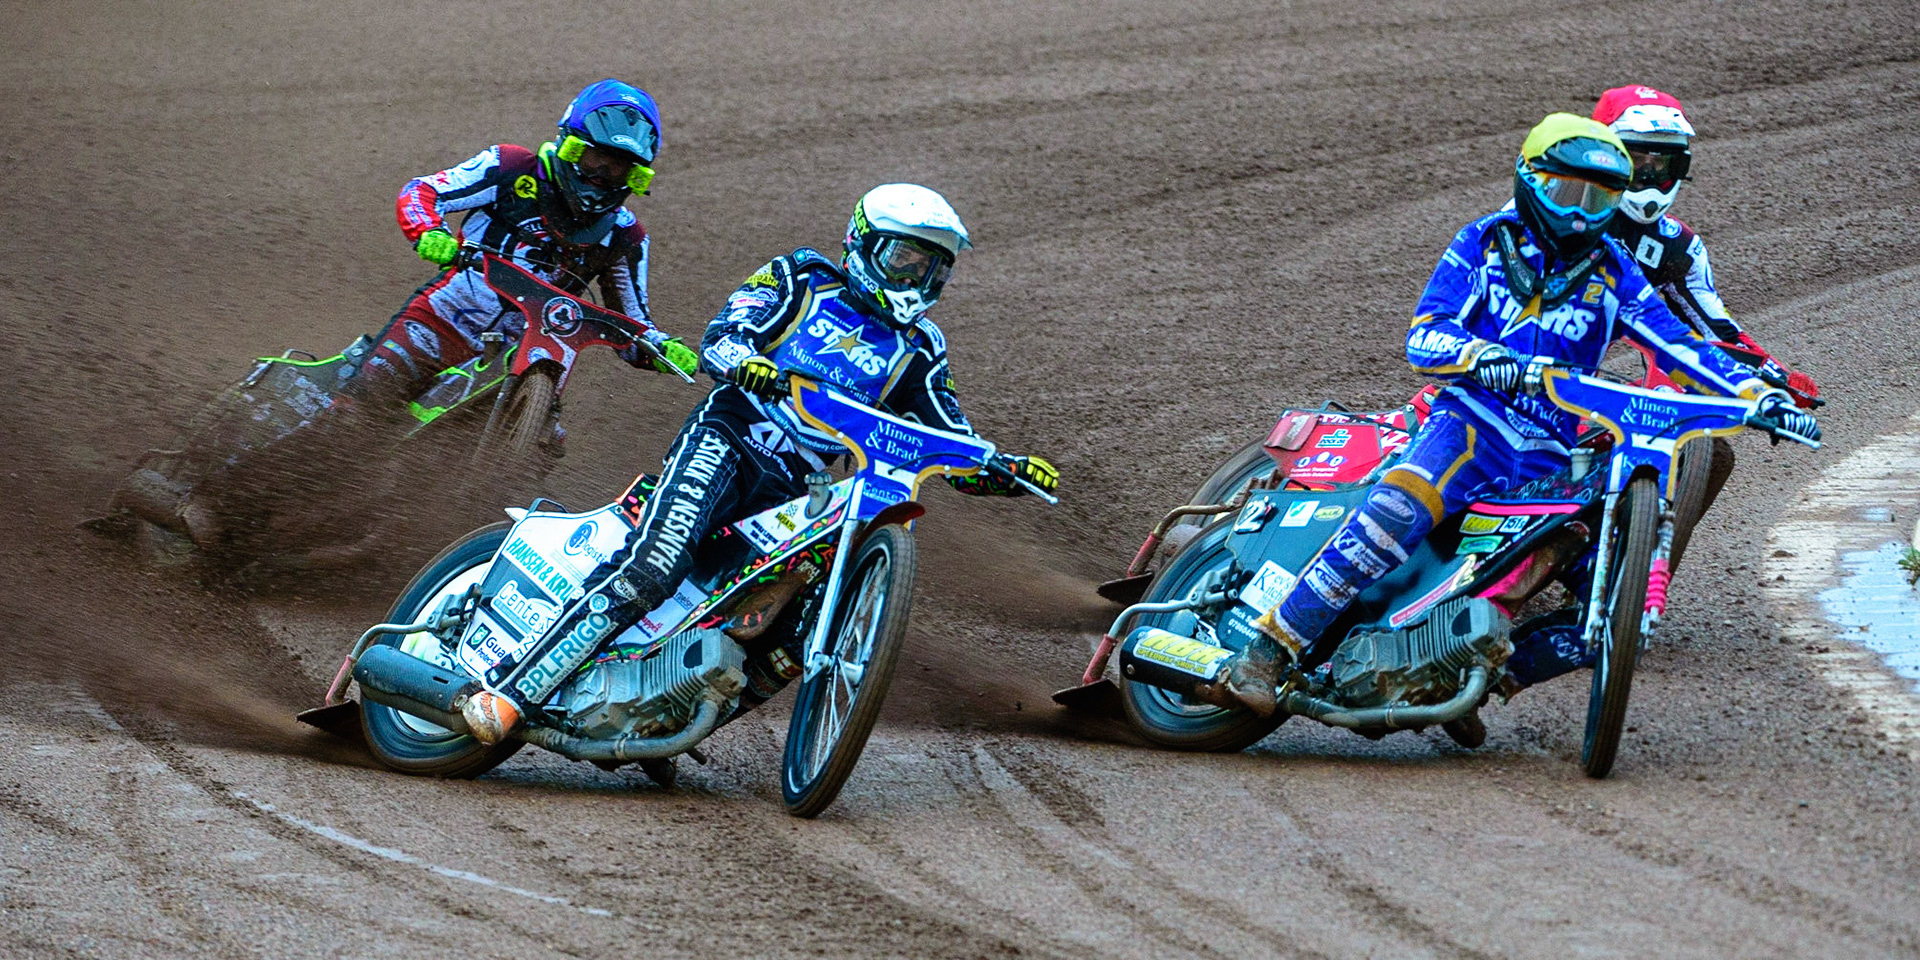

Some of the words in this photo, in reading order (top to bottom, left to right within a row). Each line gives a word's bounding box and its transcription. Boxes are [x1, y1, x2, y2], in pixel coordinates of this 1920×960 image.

[1582, 282, 1605, 305] 2
[807, 318, 888, 376] STARS
[788, 342, 829, 376] Minors
[829, 365, 844, 385] &
[1620, 406, 1638, 424] &
[1629, 396, 1679, 416] Minors
[743, 435, 773, 458] AUTO
[865, 430, 883, 450] &
[874, 420, 924, 448] Minors
[683, 433, 731, 486] KRUSE
[678, 482, 706, 500] &
[646, 497, 701, 576] HANSEN
[506, 536, 549, 576] HANSEN
[538, 565, 555, 582] &
[545, 572, 576, 601] KRU
[499, 583, 540, 627] Cente
[519, 613, 609, 699] 3PLFRIGO
